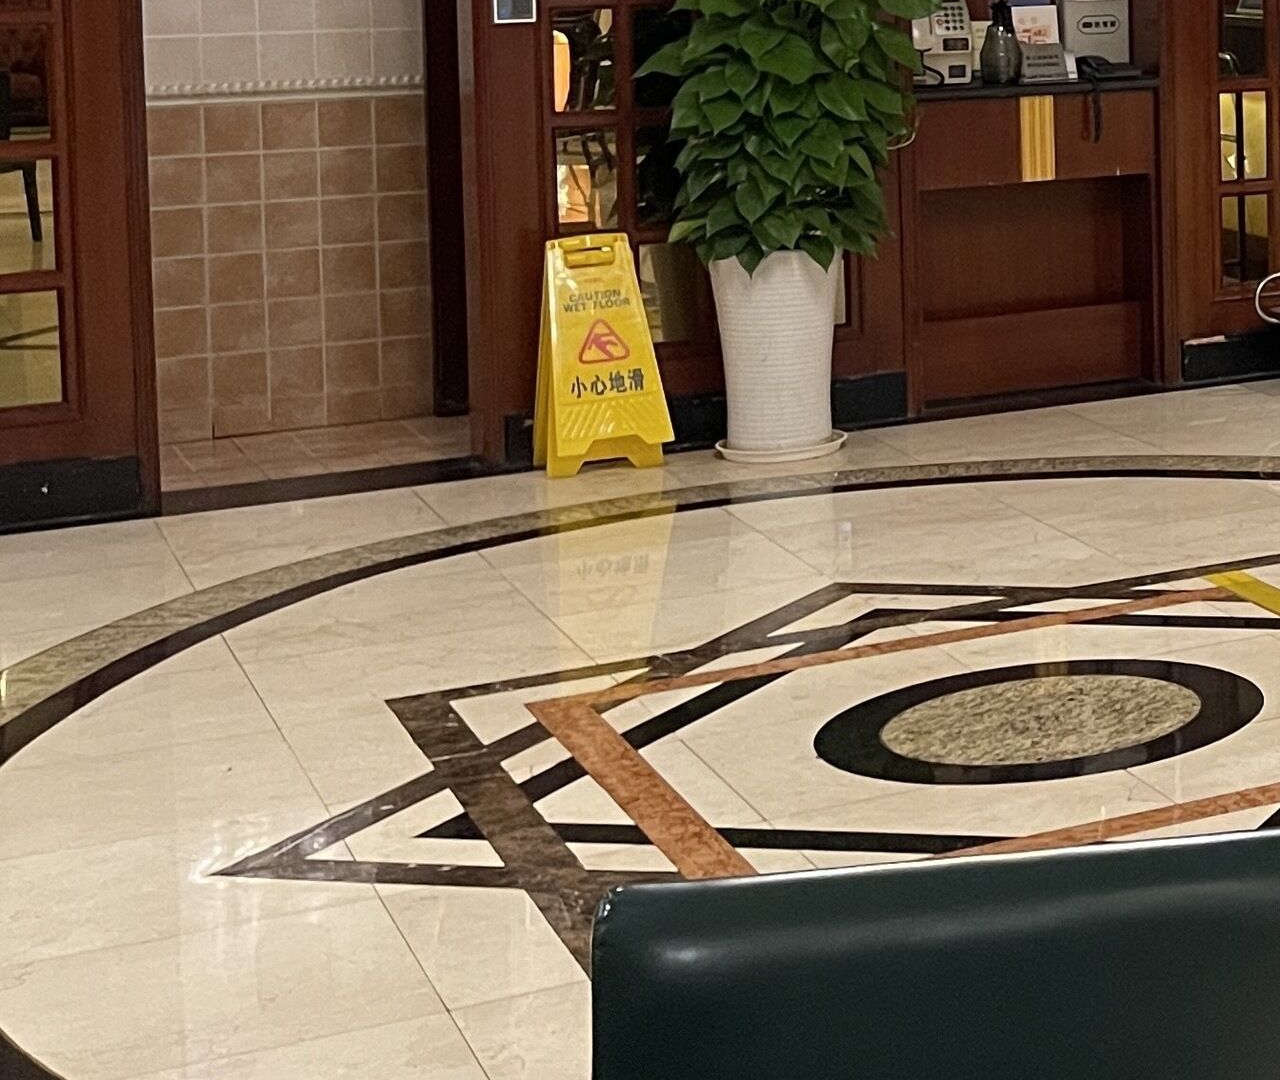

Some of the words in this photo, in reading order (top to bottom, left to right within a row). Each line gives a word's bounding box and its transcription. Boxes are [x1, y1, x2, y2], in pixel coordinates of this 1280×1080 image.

[569, 289, 621, 303] CAUTION
[563, 302, 587, 313] WET
[593, 297, 631, 311] FLOOR
[571, 368, 644, 399] 小心地滑
